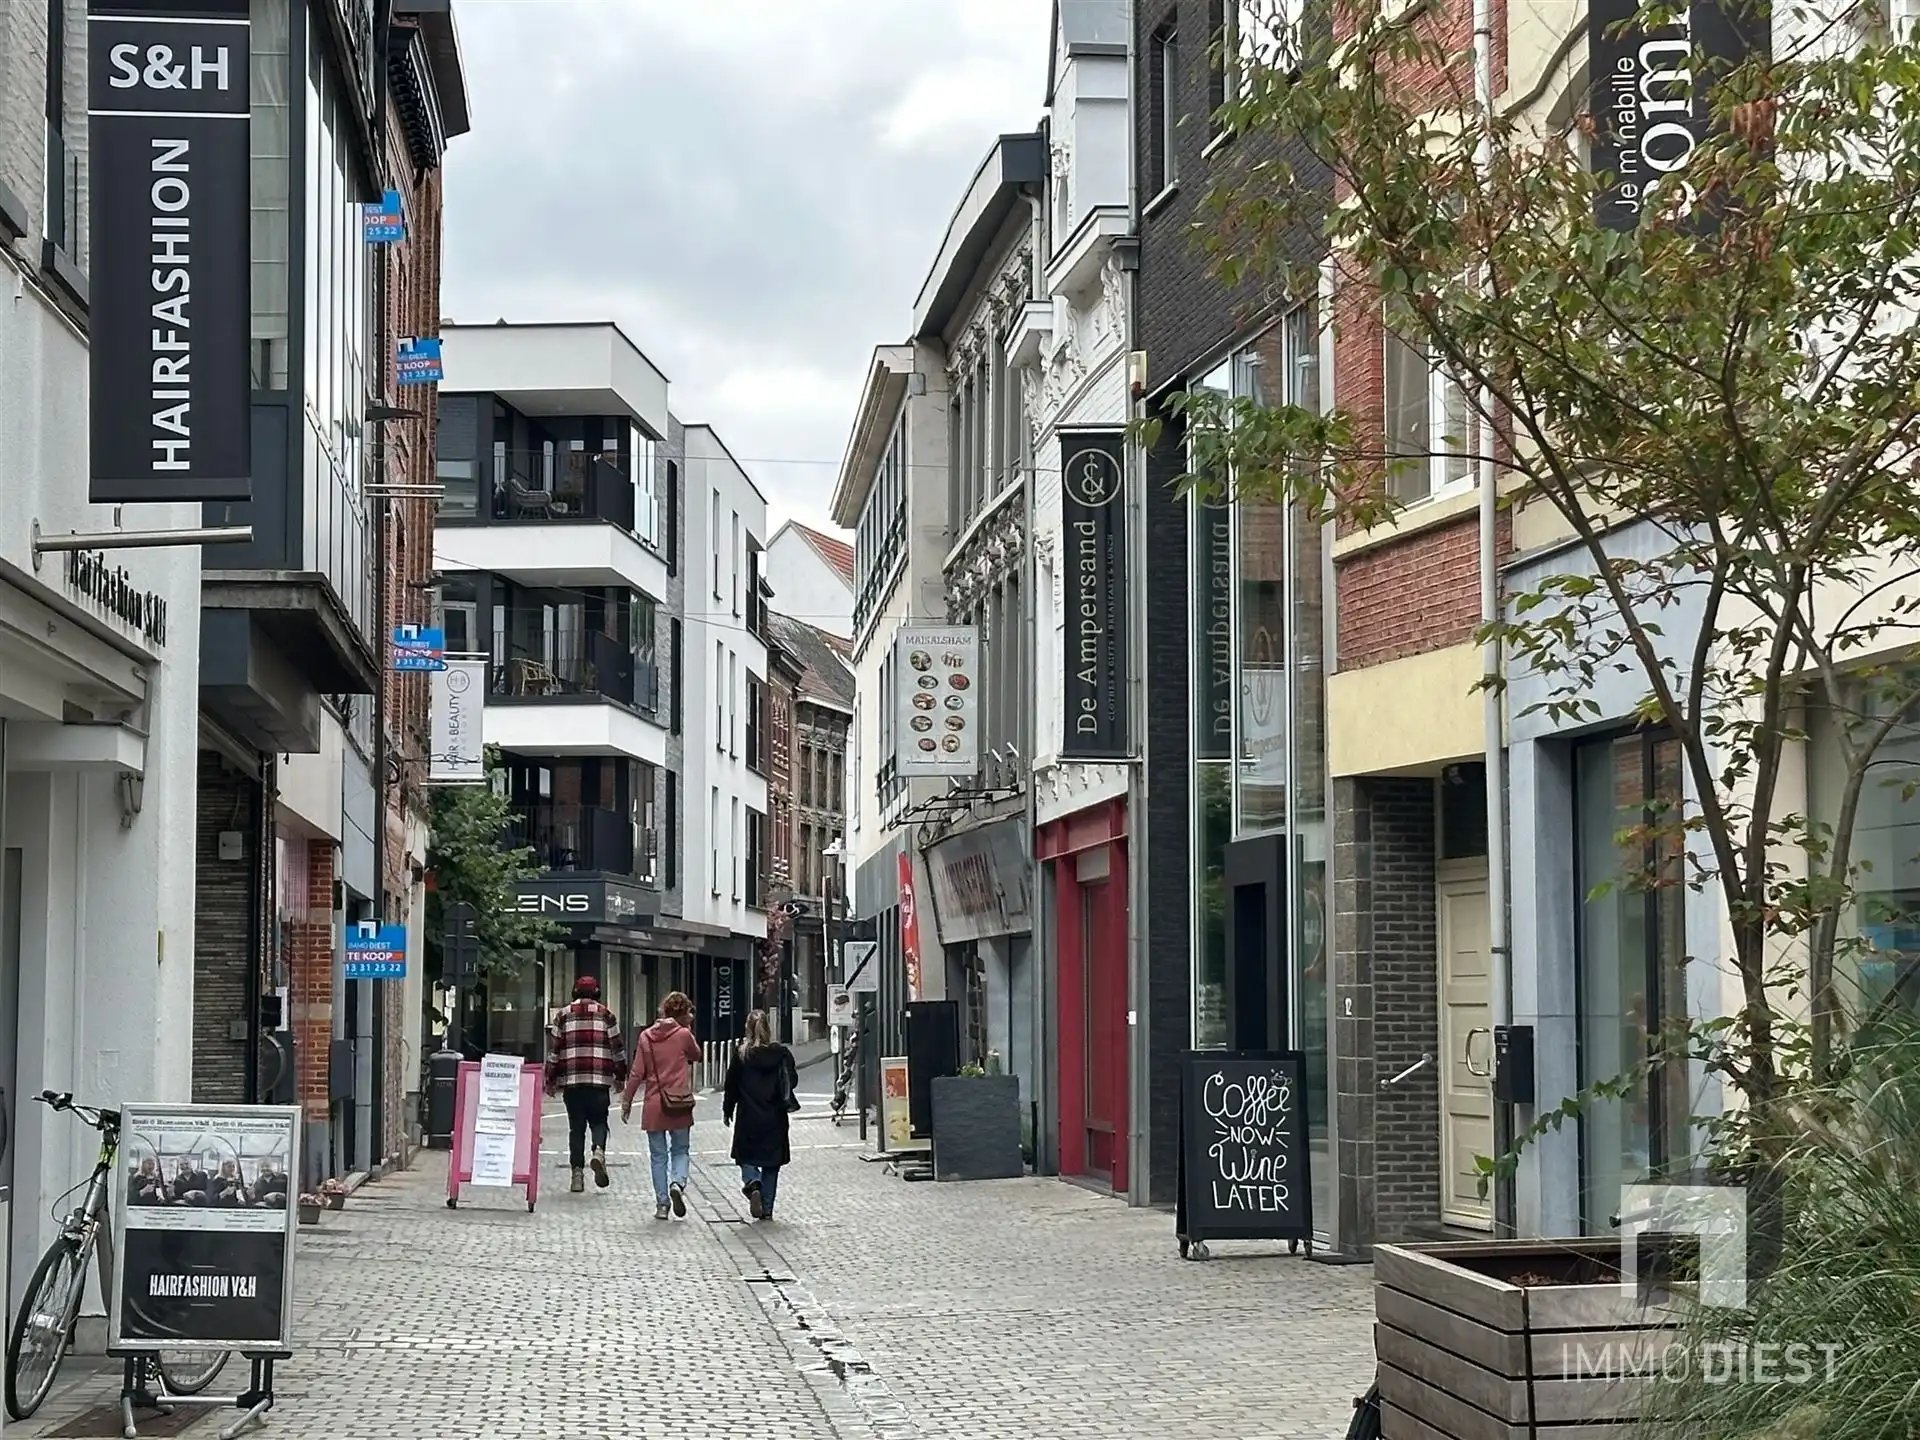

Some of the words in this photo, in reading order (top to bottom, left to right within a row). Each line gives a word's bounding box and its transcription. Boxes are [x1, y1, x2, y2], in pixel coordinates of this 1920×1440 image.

[109, 43, 229, 91] S&H
[1615, 183, 1639, 214] Je
[151, 138, 190, 471] HAIRFASHION
[1073, 519, 1103, 686] Ampersand
[449, 694, 460, 736] BEAUTY
[1077, 697, 1097, 735] De
[347, 951, 360, 960] TE
[362, 951, 393, 961] KOOP
[375, 963, 386, 972] 25
[1203, 1070, 1292, 1126] Coffee
[1230, 1126, 1275, 1146] NOW
[1209, 1143, 1288, 1183] Wine
[1212, 1180, 1290, 1212] LATER
[149, 1274, 229, 1298] HAIRFASHION
[231, 1275, 257, 1298] V&H
